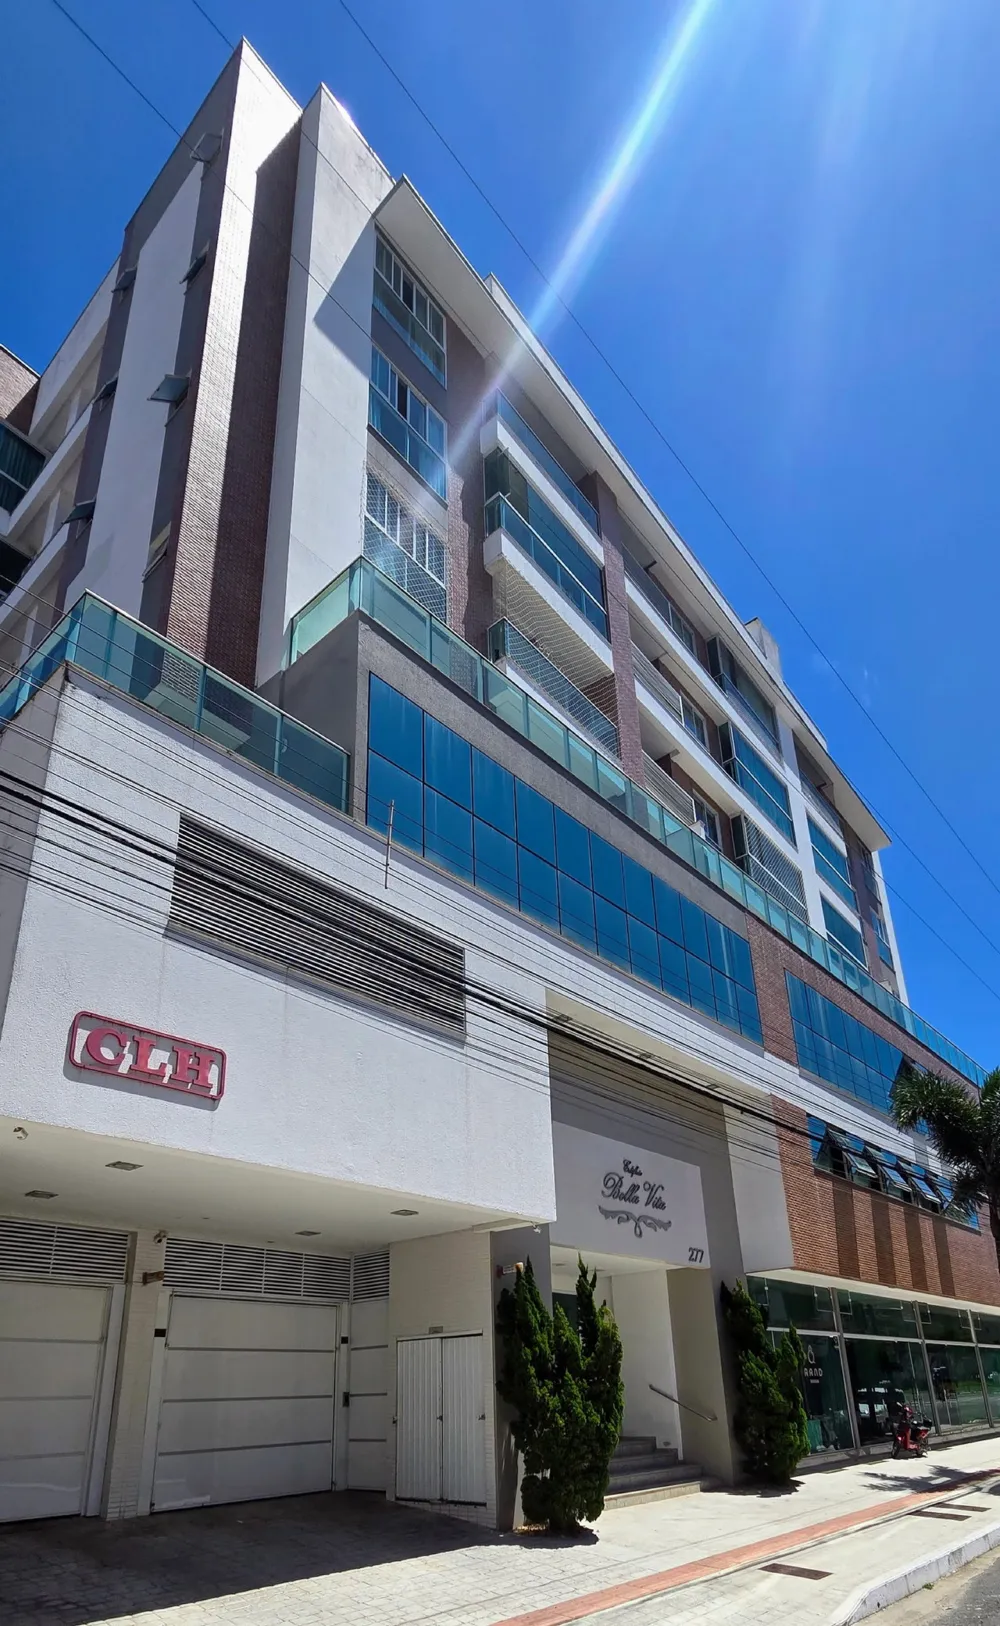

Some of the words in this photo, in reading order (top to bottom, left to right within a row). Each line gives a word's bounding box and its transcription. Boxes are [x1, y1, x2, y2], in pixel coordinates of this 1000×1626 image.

[85, 1028, 216, 1088] CLH
[601, 1172, 641, 1204] Bella
[642, 1181, 667, 1210] Vita
[688, 1247, 704, 1263] 277
